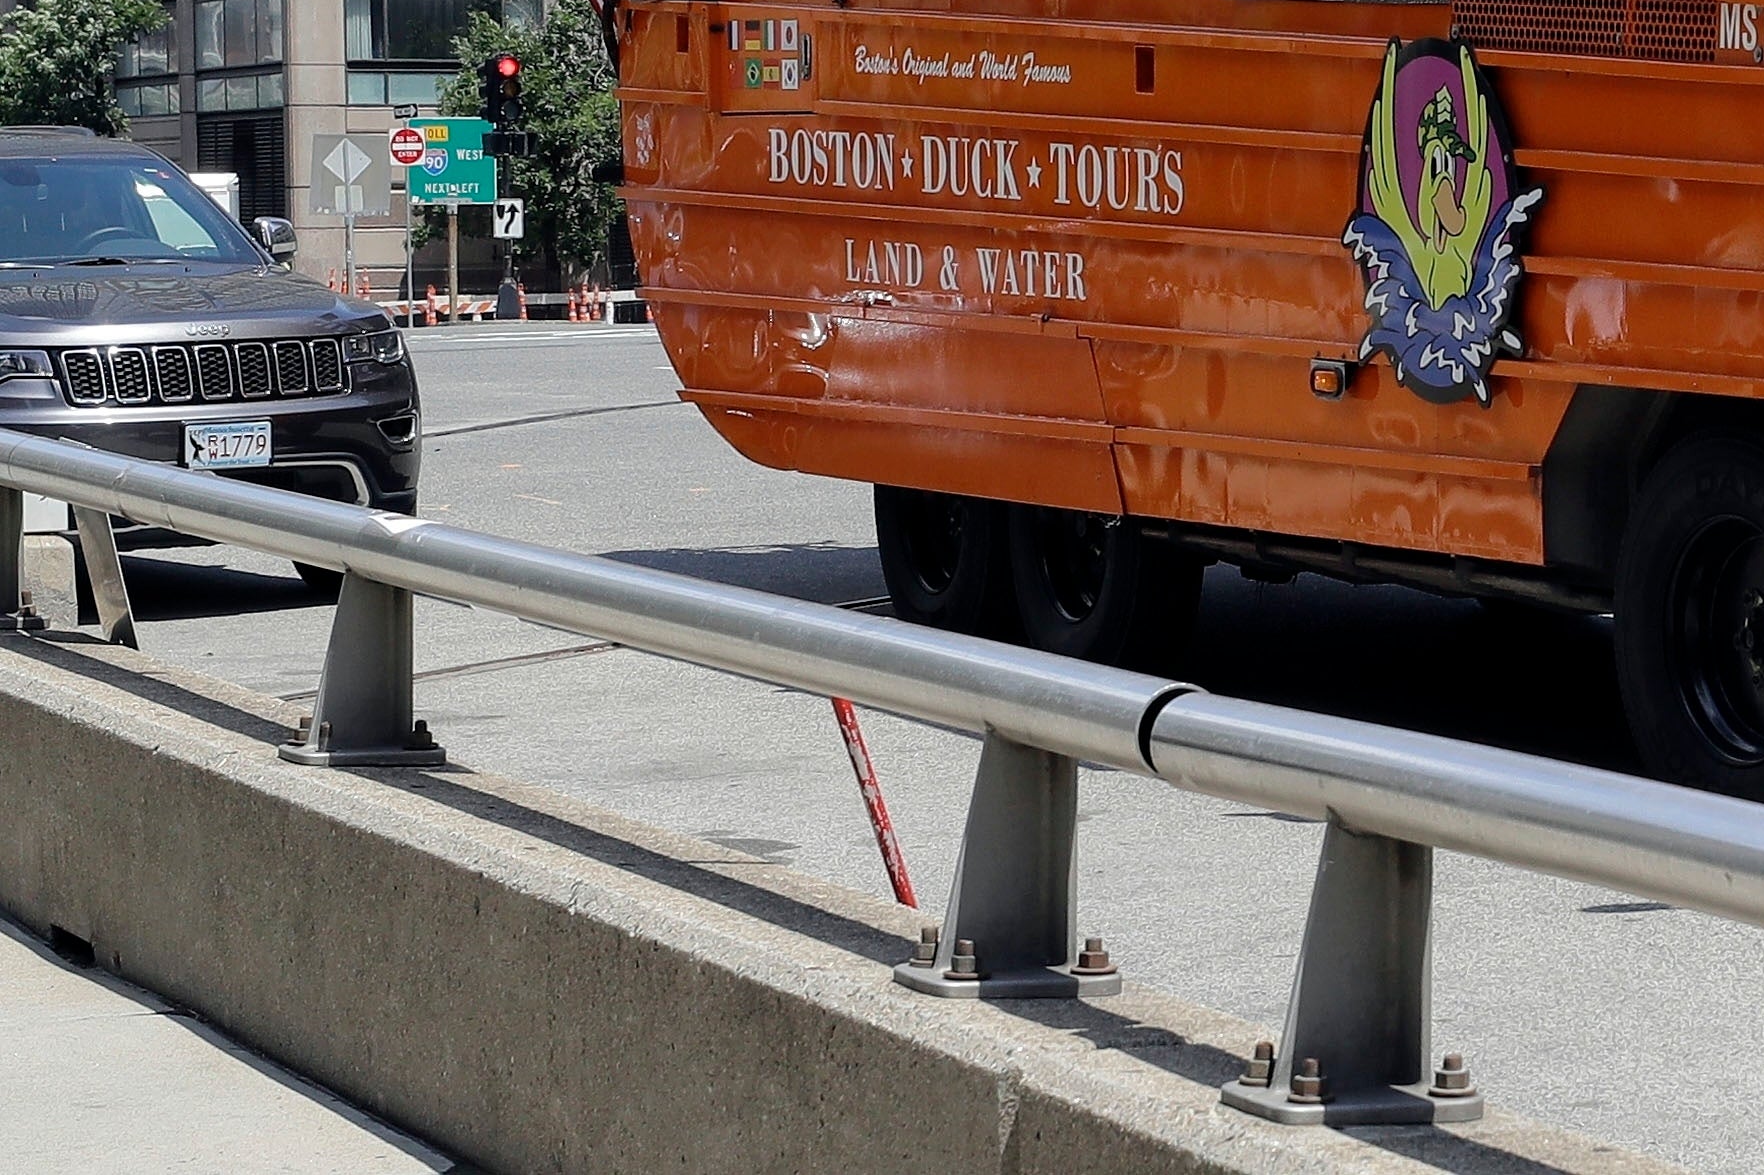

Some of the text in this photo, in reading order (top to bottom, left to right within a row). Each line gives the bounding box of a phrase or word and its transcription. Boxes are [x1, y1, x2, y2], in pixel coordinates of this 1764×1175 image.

[1719, 2, 1757, 51] MS
[854, 45, 1071, 87] Boston's Original and World Famous
[428, 129, 446, 139] OLL
[426, 156, 443, 169] 90
[456, 149, 484, 160] WEST
[768, 127, 1184, 215] BOSTON DUCK TOURS
[425, 183, 479, 194] NEXT LEFT
[846, 238, 1087, 301] LAND & WATER
[185, 322, 231, 337] Jeep
[220, 434, 267, 458] 1779
